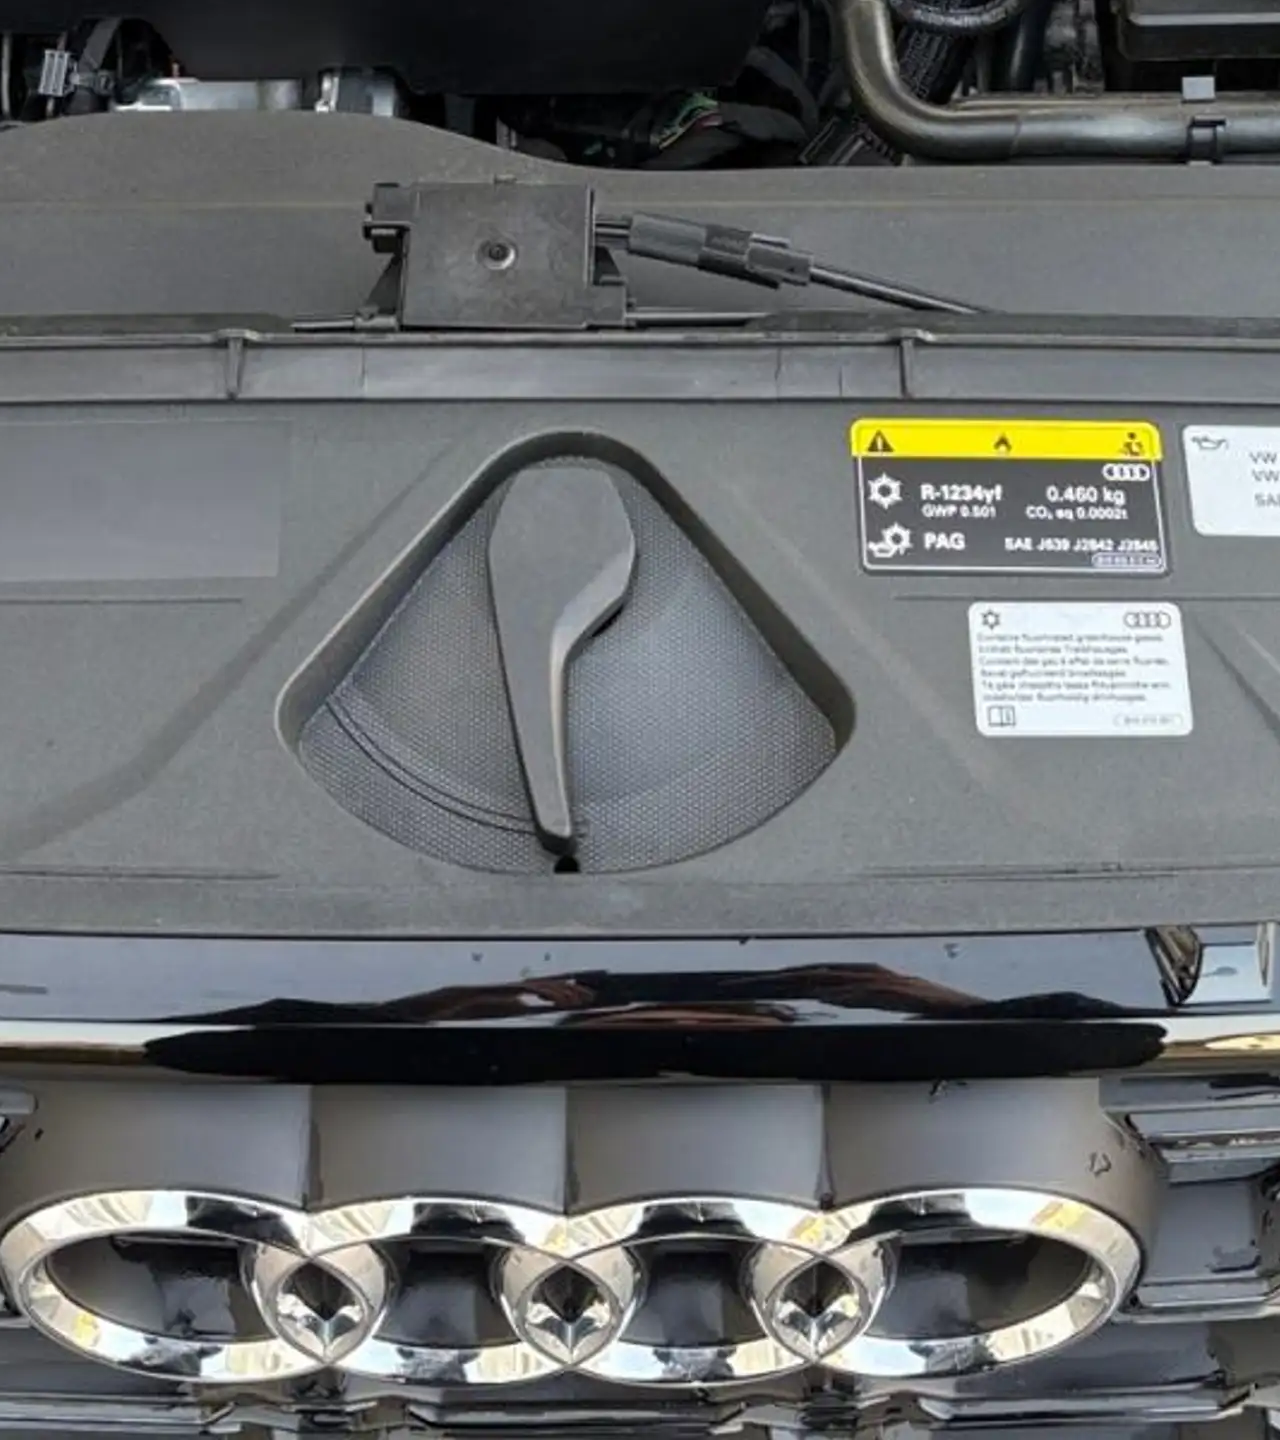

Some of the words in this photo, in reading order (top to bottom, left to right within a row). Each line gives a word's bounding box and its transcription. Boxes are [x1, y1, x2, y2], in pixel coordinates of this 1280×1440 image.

[1250, 452, 1278, 465] VW
[1251, 470, 1280, 483] VW
[920, 483, 1003, 504] R-1234yf
[1046, 485, 1098, 503] 0.460
[1103, 486, 1126, 506] kg
[922, 505, 958, 519] GWP
[923, 532, 966, 550] PAG
